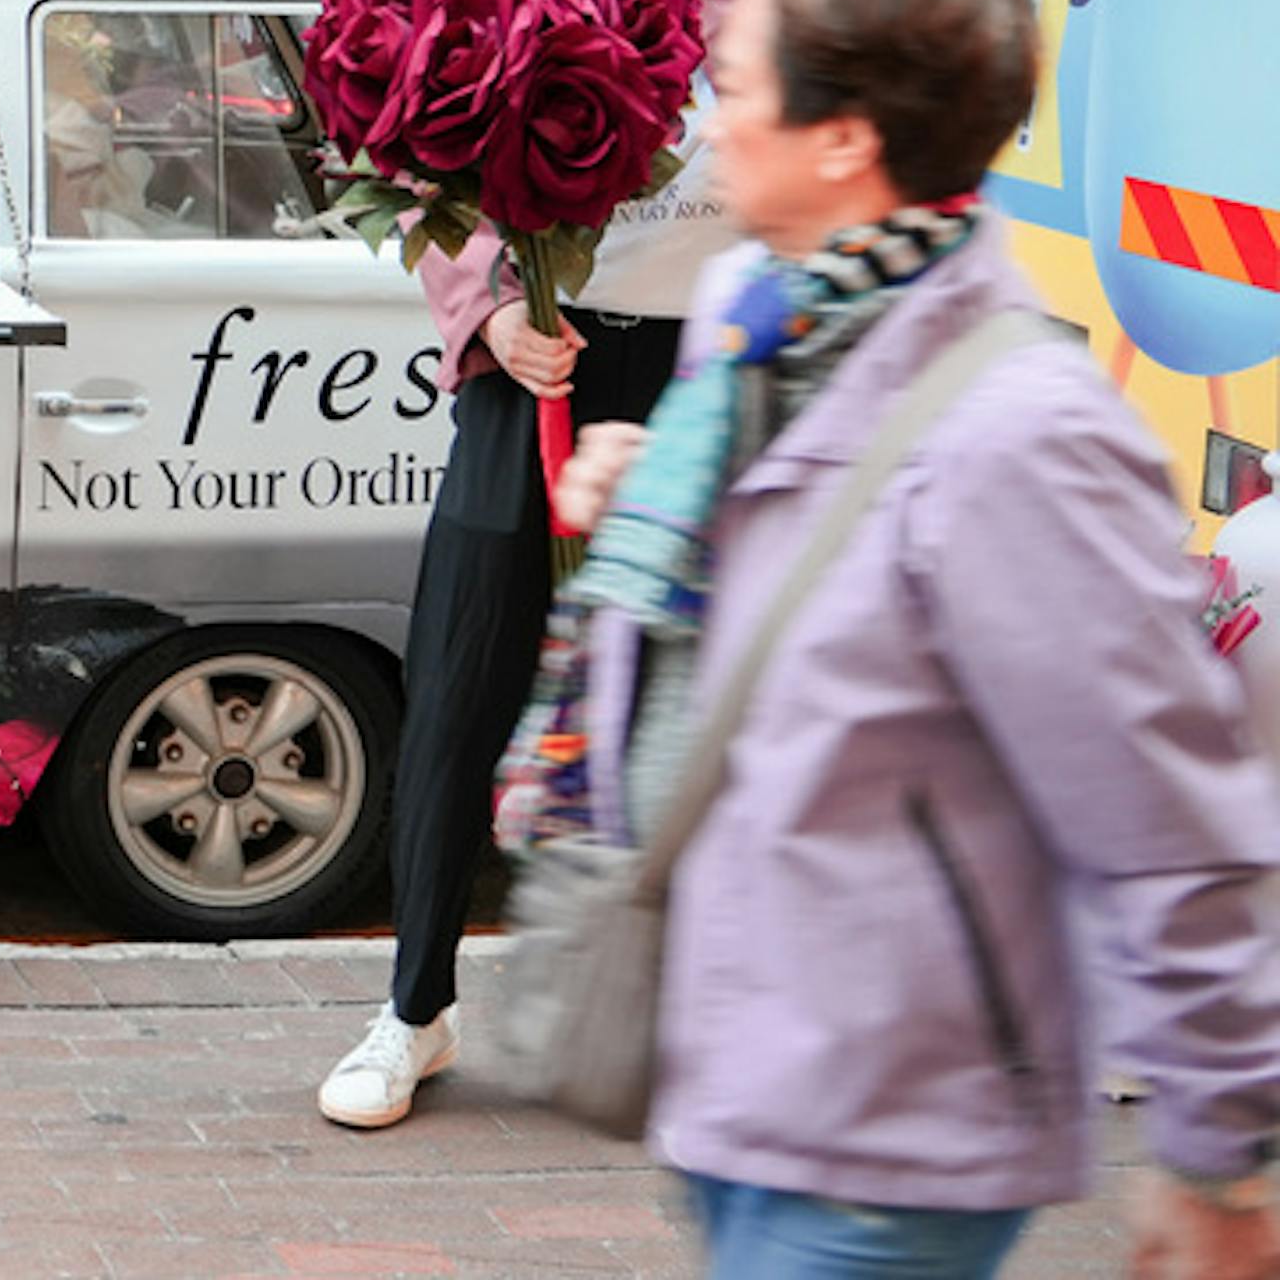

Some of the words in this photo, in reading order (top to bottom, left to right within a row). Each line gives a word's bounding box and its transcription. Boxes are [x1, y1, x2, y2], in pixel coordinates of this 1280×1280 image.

[182, 307, 442, 445] fres
[39, 460, 140, 511] Not
[158, 460, 286, 510] Your
[300, 453, 445, 508] Ordin
